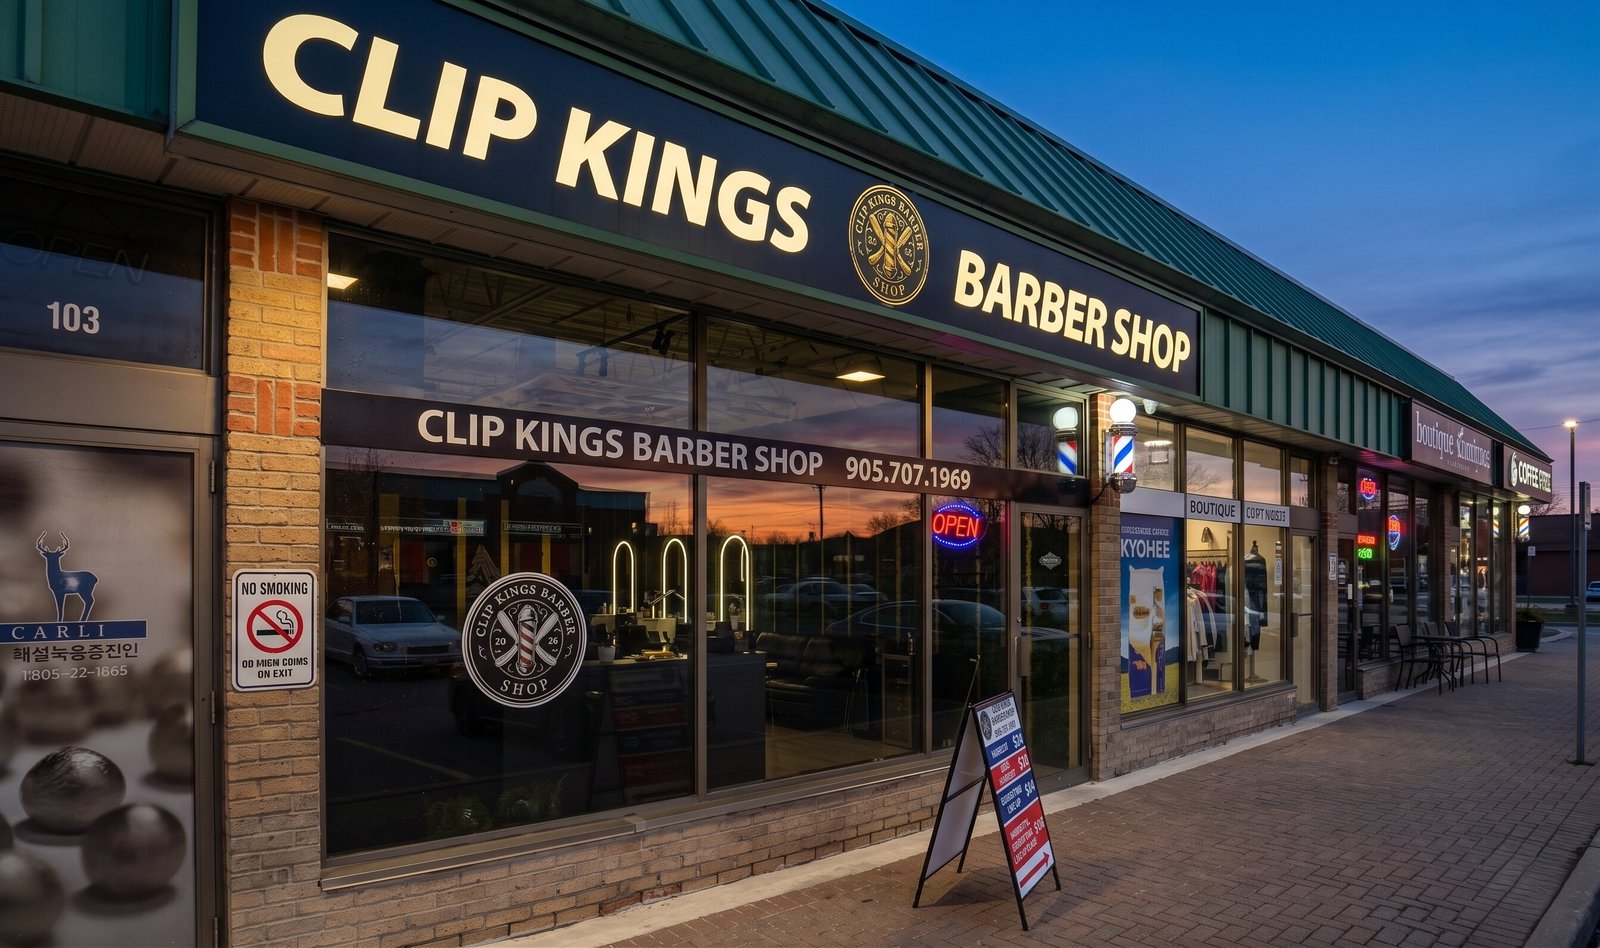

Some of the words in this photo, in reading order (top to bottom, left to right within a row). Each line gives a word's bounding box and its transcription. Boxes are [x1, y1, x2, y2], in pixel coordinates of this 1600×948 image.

[262, 13, 538, 161] CLIP
[555, 106, 812, 254] KINGS
[855, 205, 868, 234] CLIP
[867, 194, 897, 209] KINGS
[898, 202, 924, 250] BARBER
[872, 276, 905, 296] SHOP
[46, 301, 100, 335] 103
[954, 249, 1108, 350] BARBER
[1110, 308, 1191, 373] SHOP
[1416, 411, 1454, 459] boutique
[417, 409, 505, 447] CLIP
[515, 418, 624, 459] KINGS
[632, 431, 748, 470] BARBER
[754, 446, 823, 476] SHOP
[845, 456, 971, 491] 905.707.1969
[1518, 460, 1539, 489] COFFEE
[1190, 500, 1236, 518] BOUTIQUE
[932, 513, 980, 538] OPEN
[1120, 538, 1170, 558] KYOHEE
[241, 582, 257, 595] NO
[260, 582, 308, 595] SMOKING
[475, 604, 495, 637] CLIP
[494, 584, 537, 604] KINGS
[540, 587, 576, 636] BARBER
[11, 624, 105, 640] CARLI
[494, 637, 507, 646] 20
[548, 637, 559, 645] 26
[257, 669, 271, 678] ON
[273, 668, 294, 678] EXIT
[500, 678, 548, 695] SHOP
